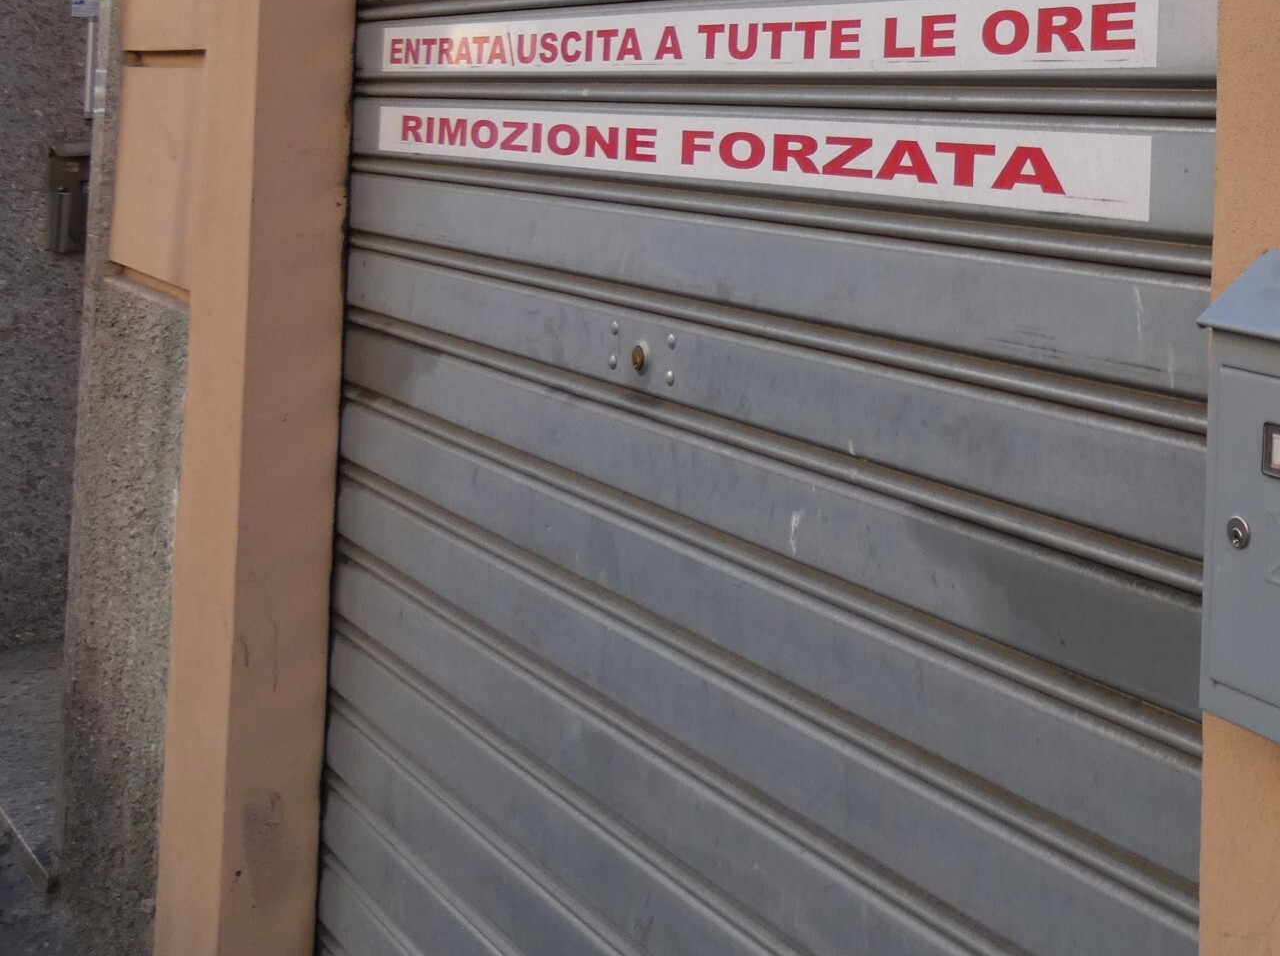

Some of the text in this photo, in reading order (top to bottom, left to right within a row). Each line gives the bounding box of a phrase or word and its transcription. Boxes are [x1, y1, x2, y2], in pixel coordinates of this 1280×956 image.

[655, 25, 683, 60] A
[698, 20, 862, 60] TUTTE
[883, 14, 957, 59] LE
[981, 1, 1136, 55] ORE
[401, 114, 1066, 196] RIMOZIONE FORZATA
